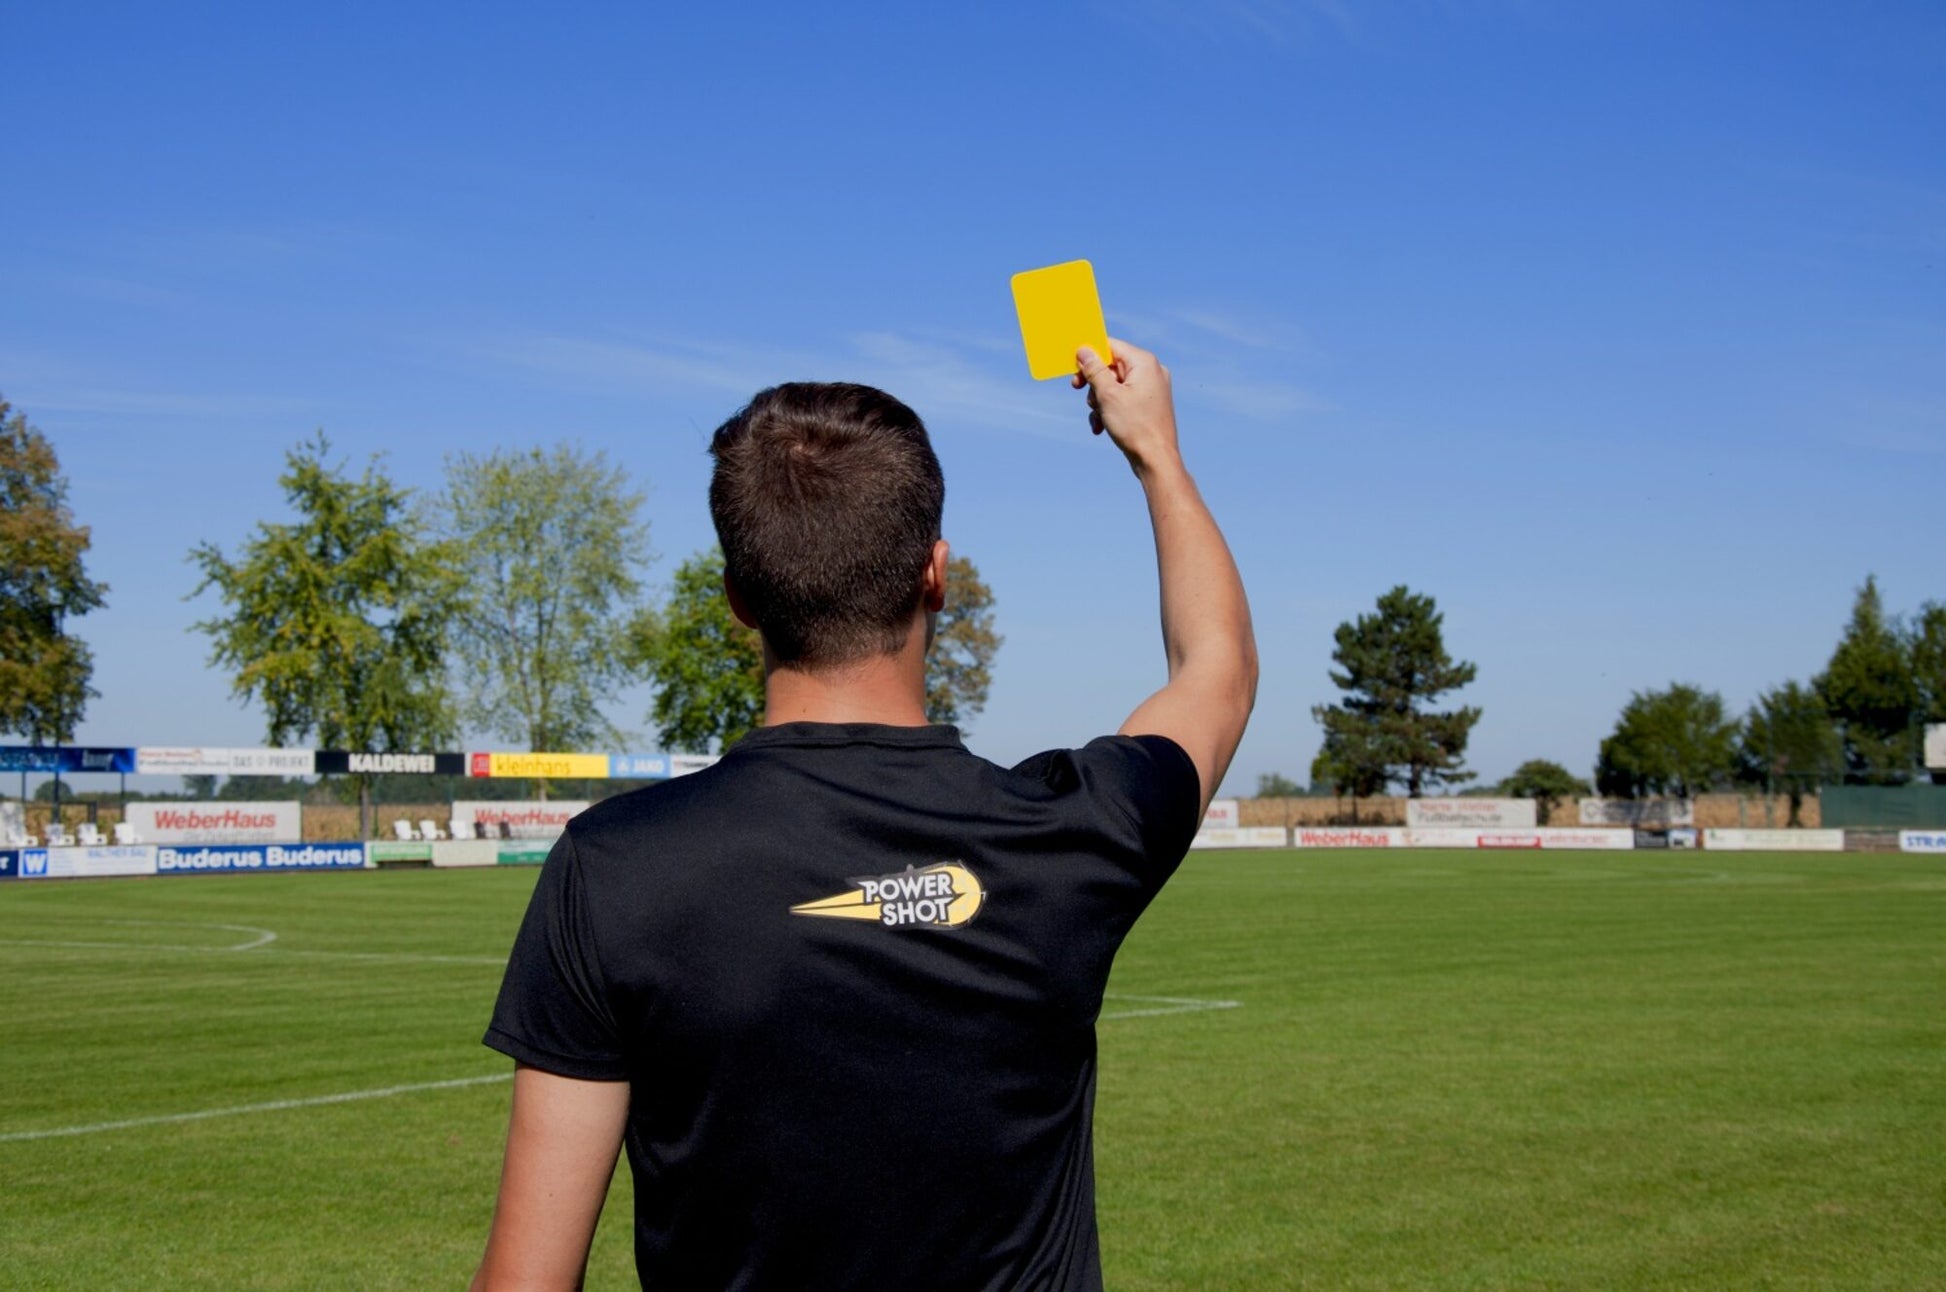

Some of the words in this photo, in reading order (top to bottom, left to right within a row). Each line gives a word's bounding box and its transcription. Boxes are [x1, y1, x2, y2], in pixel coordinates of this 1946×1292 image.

[350, 754, 435, 773] KALDEWEI
[496, 755, 571, 775] kleinhans
[154, 810, 276, 829] WeberHaus
[474, 809, 570, 826] WeberHaus
[1301, 832, 1389, 846] WeberHaus
[158, 849, 262, 870] Buderus
[266, 846, 362, 867] Buderus
[858, 873, 953, 902] POWER
[882, 897, 954, 926] SHOT
